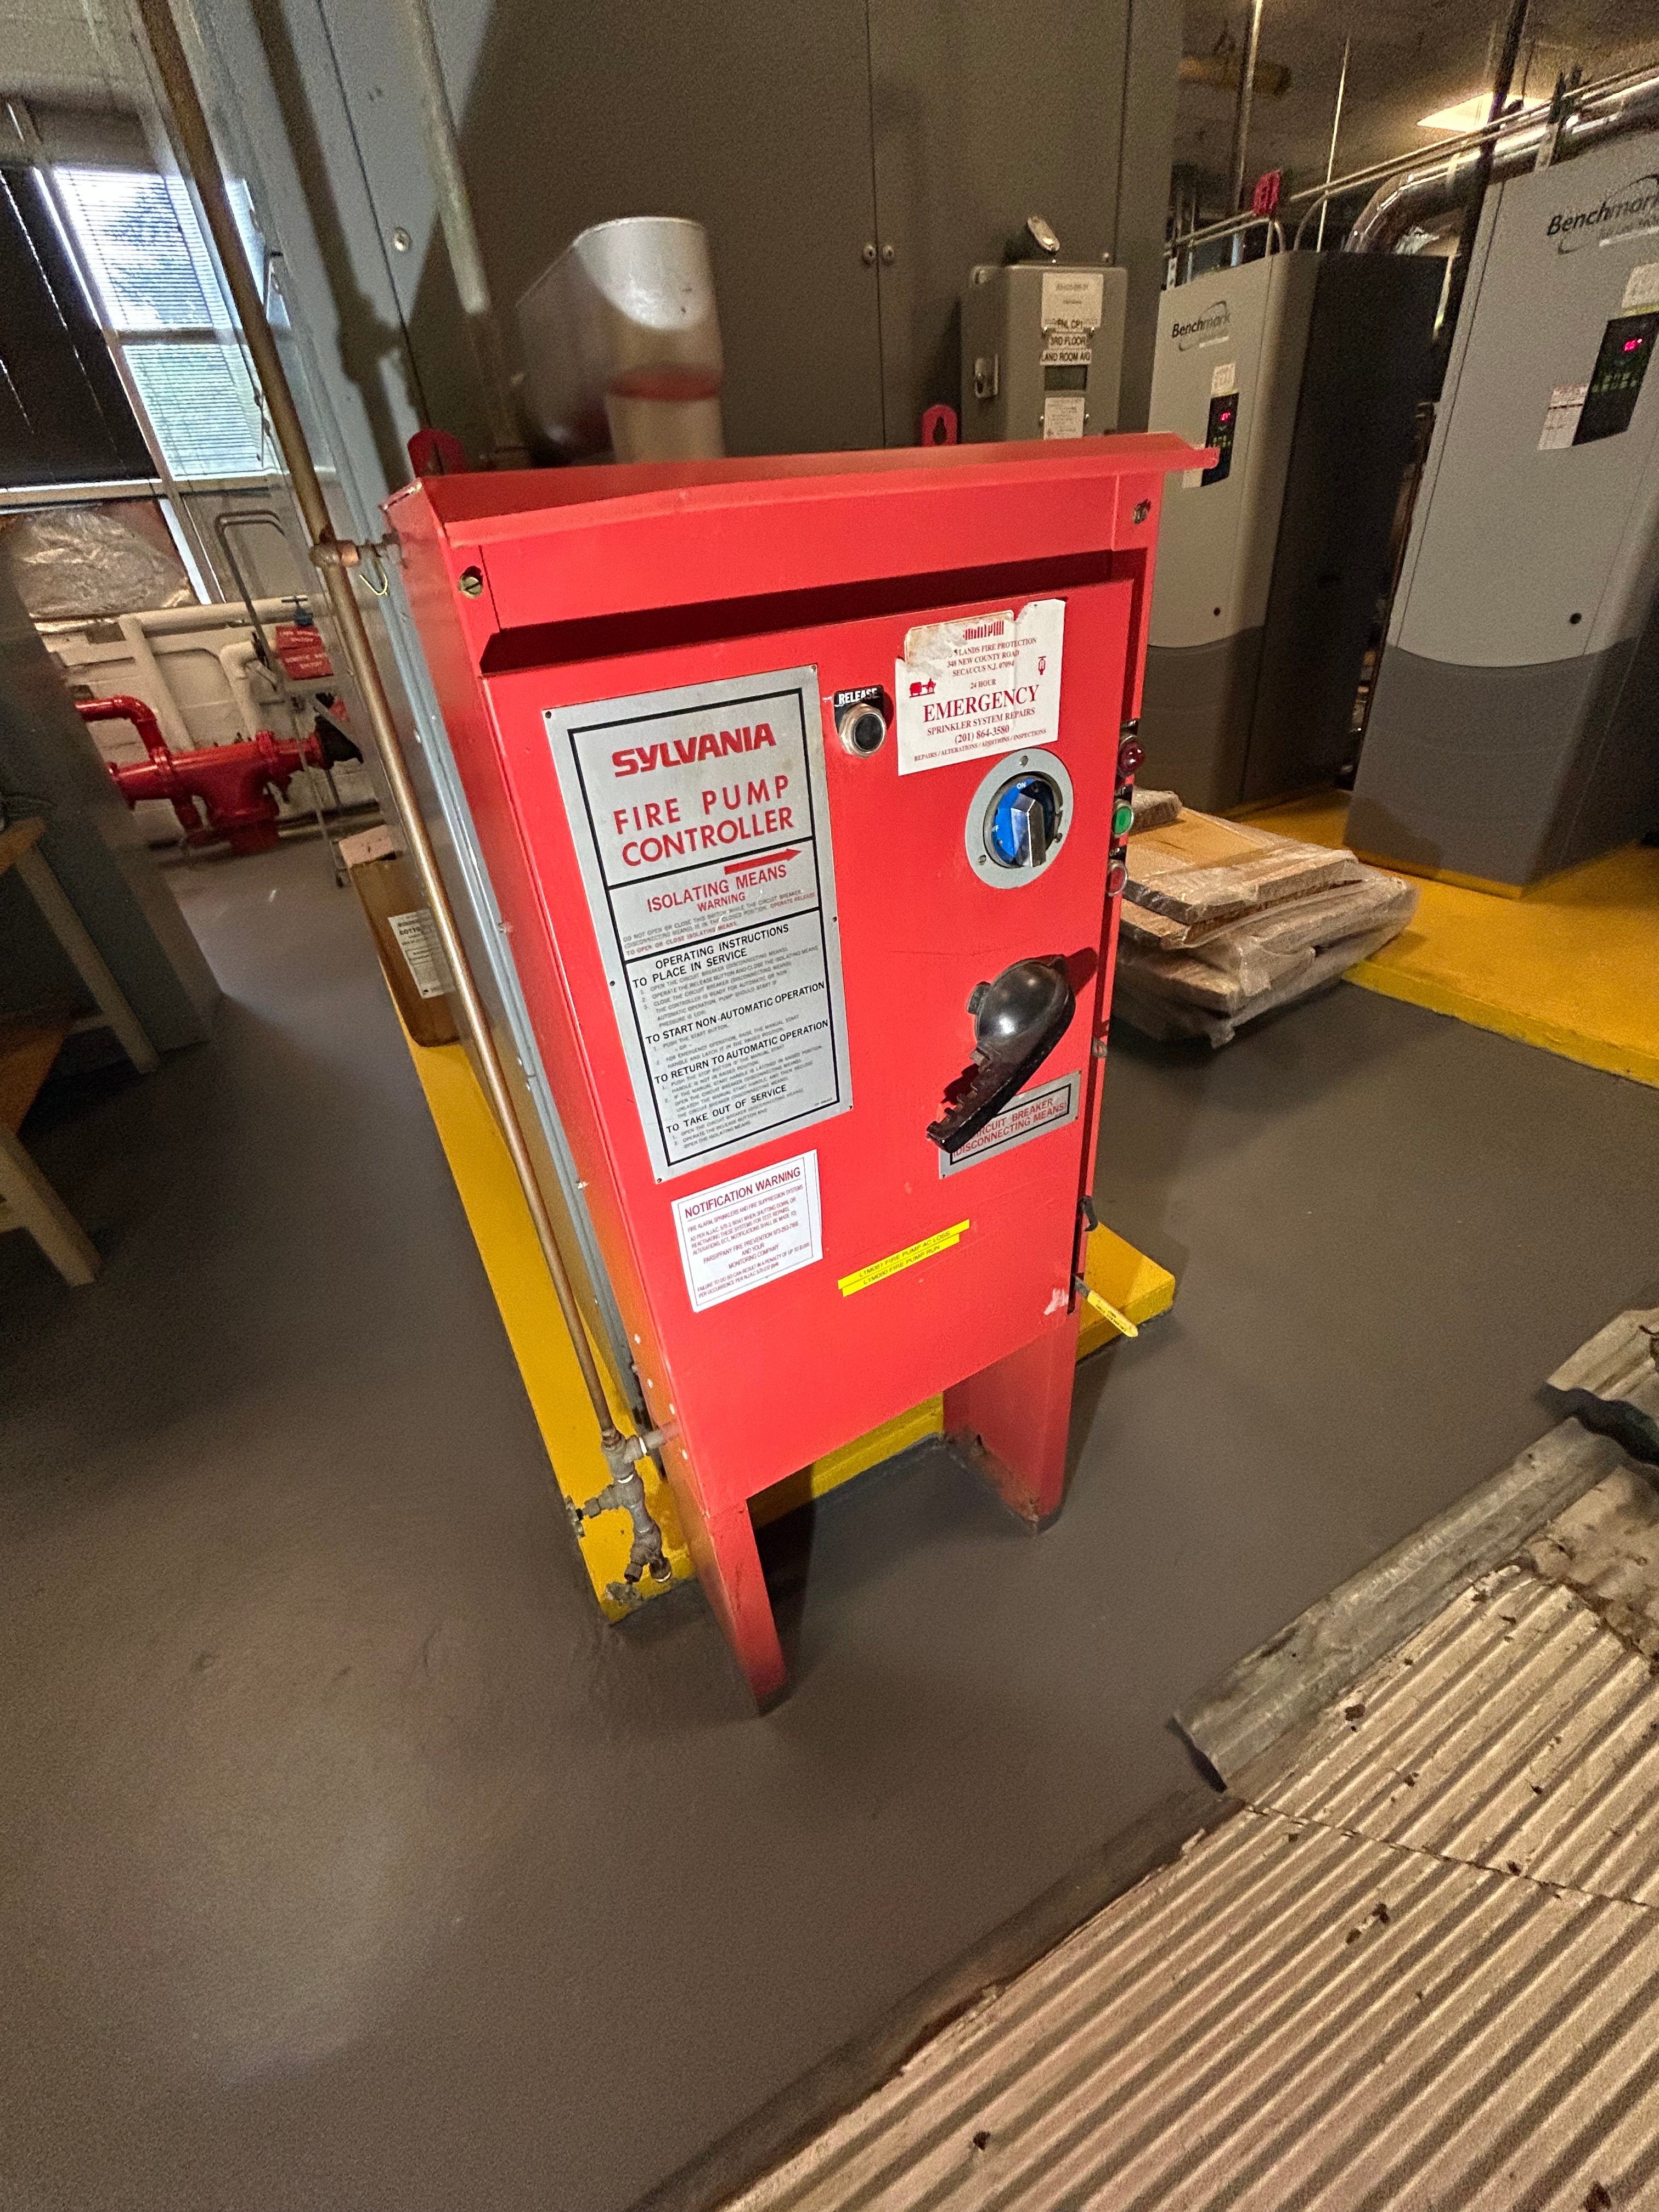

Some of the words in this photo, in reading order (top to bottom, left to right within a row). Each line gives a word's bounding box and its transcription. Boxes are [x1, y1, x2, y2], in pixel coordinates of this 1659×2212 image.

[1172, 313, 1231, 338] Benchmark
[1065, 335, 1086, 346] FLOOR
[1059, 352, 1079, 362] ROOM
[958, 657, 973, 666] NEW
[974, 653, 1000, 663] COUNTY
[1001, 649, 1019, 659] ROAD
[981, 644, 997, 653] FIRE
[997, 637, 1037, 650] PROTECTION
[952, 665, 986, 677] SECAUCUS
[970, 681, 977, 690] 24
[978, 678, 996, 688] HOUR
[838, 687, 881, 705] RELEASE
[923, 684, 1040, 723] EMERGENCY
[927, 719, 972, 736] SPRINKLER
[972, 713, 1003, 727] SYSTEM
[1005, 707, 1036, 720] REPAIRS
[955, 732, 974, 745] (201)
[975, 724, 1009, 740] 864-3580
[610, 721, 776, 778] SYLVANIA
[914, 751, 938, 761] REPAIRS
[941, 742, 978, 756] ALTERATIONS
[1013, 728, 1047, 741] INSPECTIONS
[1016, 781, 1026, 789] ON
[612, 797, 682, 836] FIRE
[702, 774, 791, 816] PUMP
[619, 805, 794, 869] CONTROLLER
[646, 878, 730, 913] ISOLATING
[735, 863, 787, 890] MEANS
[696, 890, 746, 914] WARNING
[654, 944, 715, 970] OPERATING
[718, 923, 789, 951] INSTRUCTIONS
[665, 935, 685, 946] CLOSE
[631, 975, 648, 989] TO
[652, 964, 687, 983] PLACE
[690, 960, 702, 972] IN
[705, 947, 748, 967] SERVICE
[645, 1032, 661, 1045] TO
[662, 1022, 695, 1040] START
[695, 997, 774, 1029] NON-AUTOMATIC
[774, 980, 825, 1004] OPERATION
[653, 1073, 669, 1085] TO
[670, 1059, 709, 1079] RETURN
[710, 1053, 725, 1065] TO
[725, 1035, 778, 1060] AUTOMATIC
[778, 1018, 828, 1042] OPERATION
[665, 1122, 680, 1134] TO
[682, 1111, 709, 1128] TAKE
[712, 1104, 732, 1118] OUT
[734, 1098, 748, 1109] OF
[749, 1084, 787, 1104] SERVICE
[975, 1117, 1007, 1138] IRCUIT
[1012, 1097, 1053, 1122] BREAKER
[1033, 1101, 1067, 1122] MEANS)
[684, 1183, 753, 1219] NOTIFICATION
[755, 1166, 800, 1192] WARNING
[732, 1242, 744, 1252] FIRE
[743, 1231, 772, 1248] PREVENTION
[741, 1247, 752, 1256] AND
[752, 1242, 765, 1252] YOUR
[884, 1255, 901, 1266] FIRE
[902, 1245, 921, 1258] PUMP
[922, 1239, 932, 1248] AC
[932, 1231, 950, 1243] LOSS
[727, 1252, 757, 1269] MONITORING
[757, 1243, 779, 1257] COMPANY
[889, 1261, 904, 1272] FIRE
[905, 1251, 925, 1264] PUMP
[926, 1245, 940, 1255] RUN
